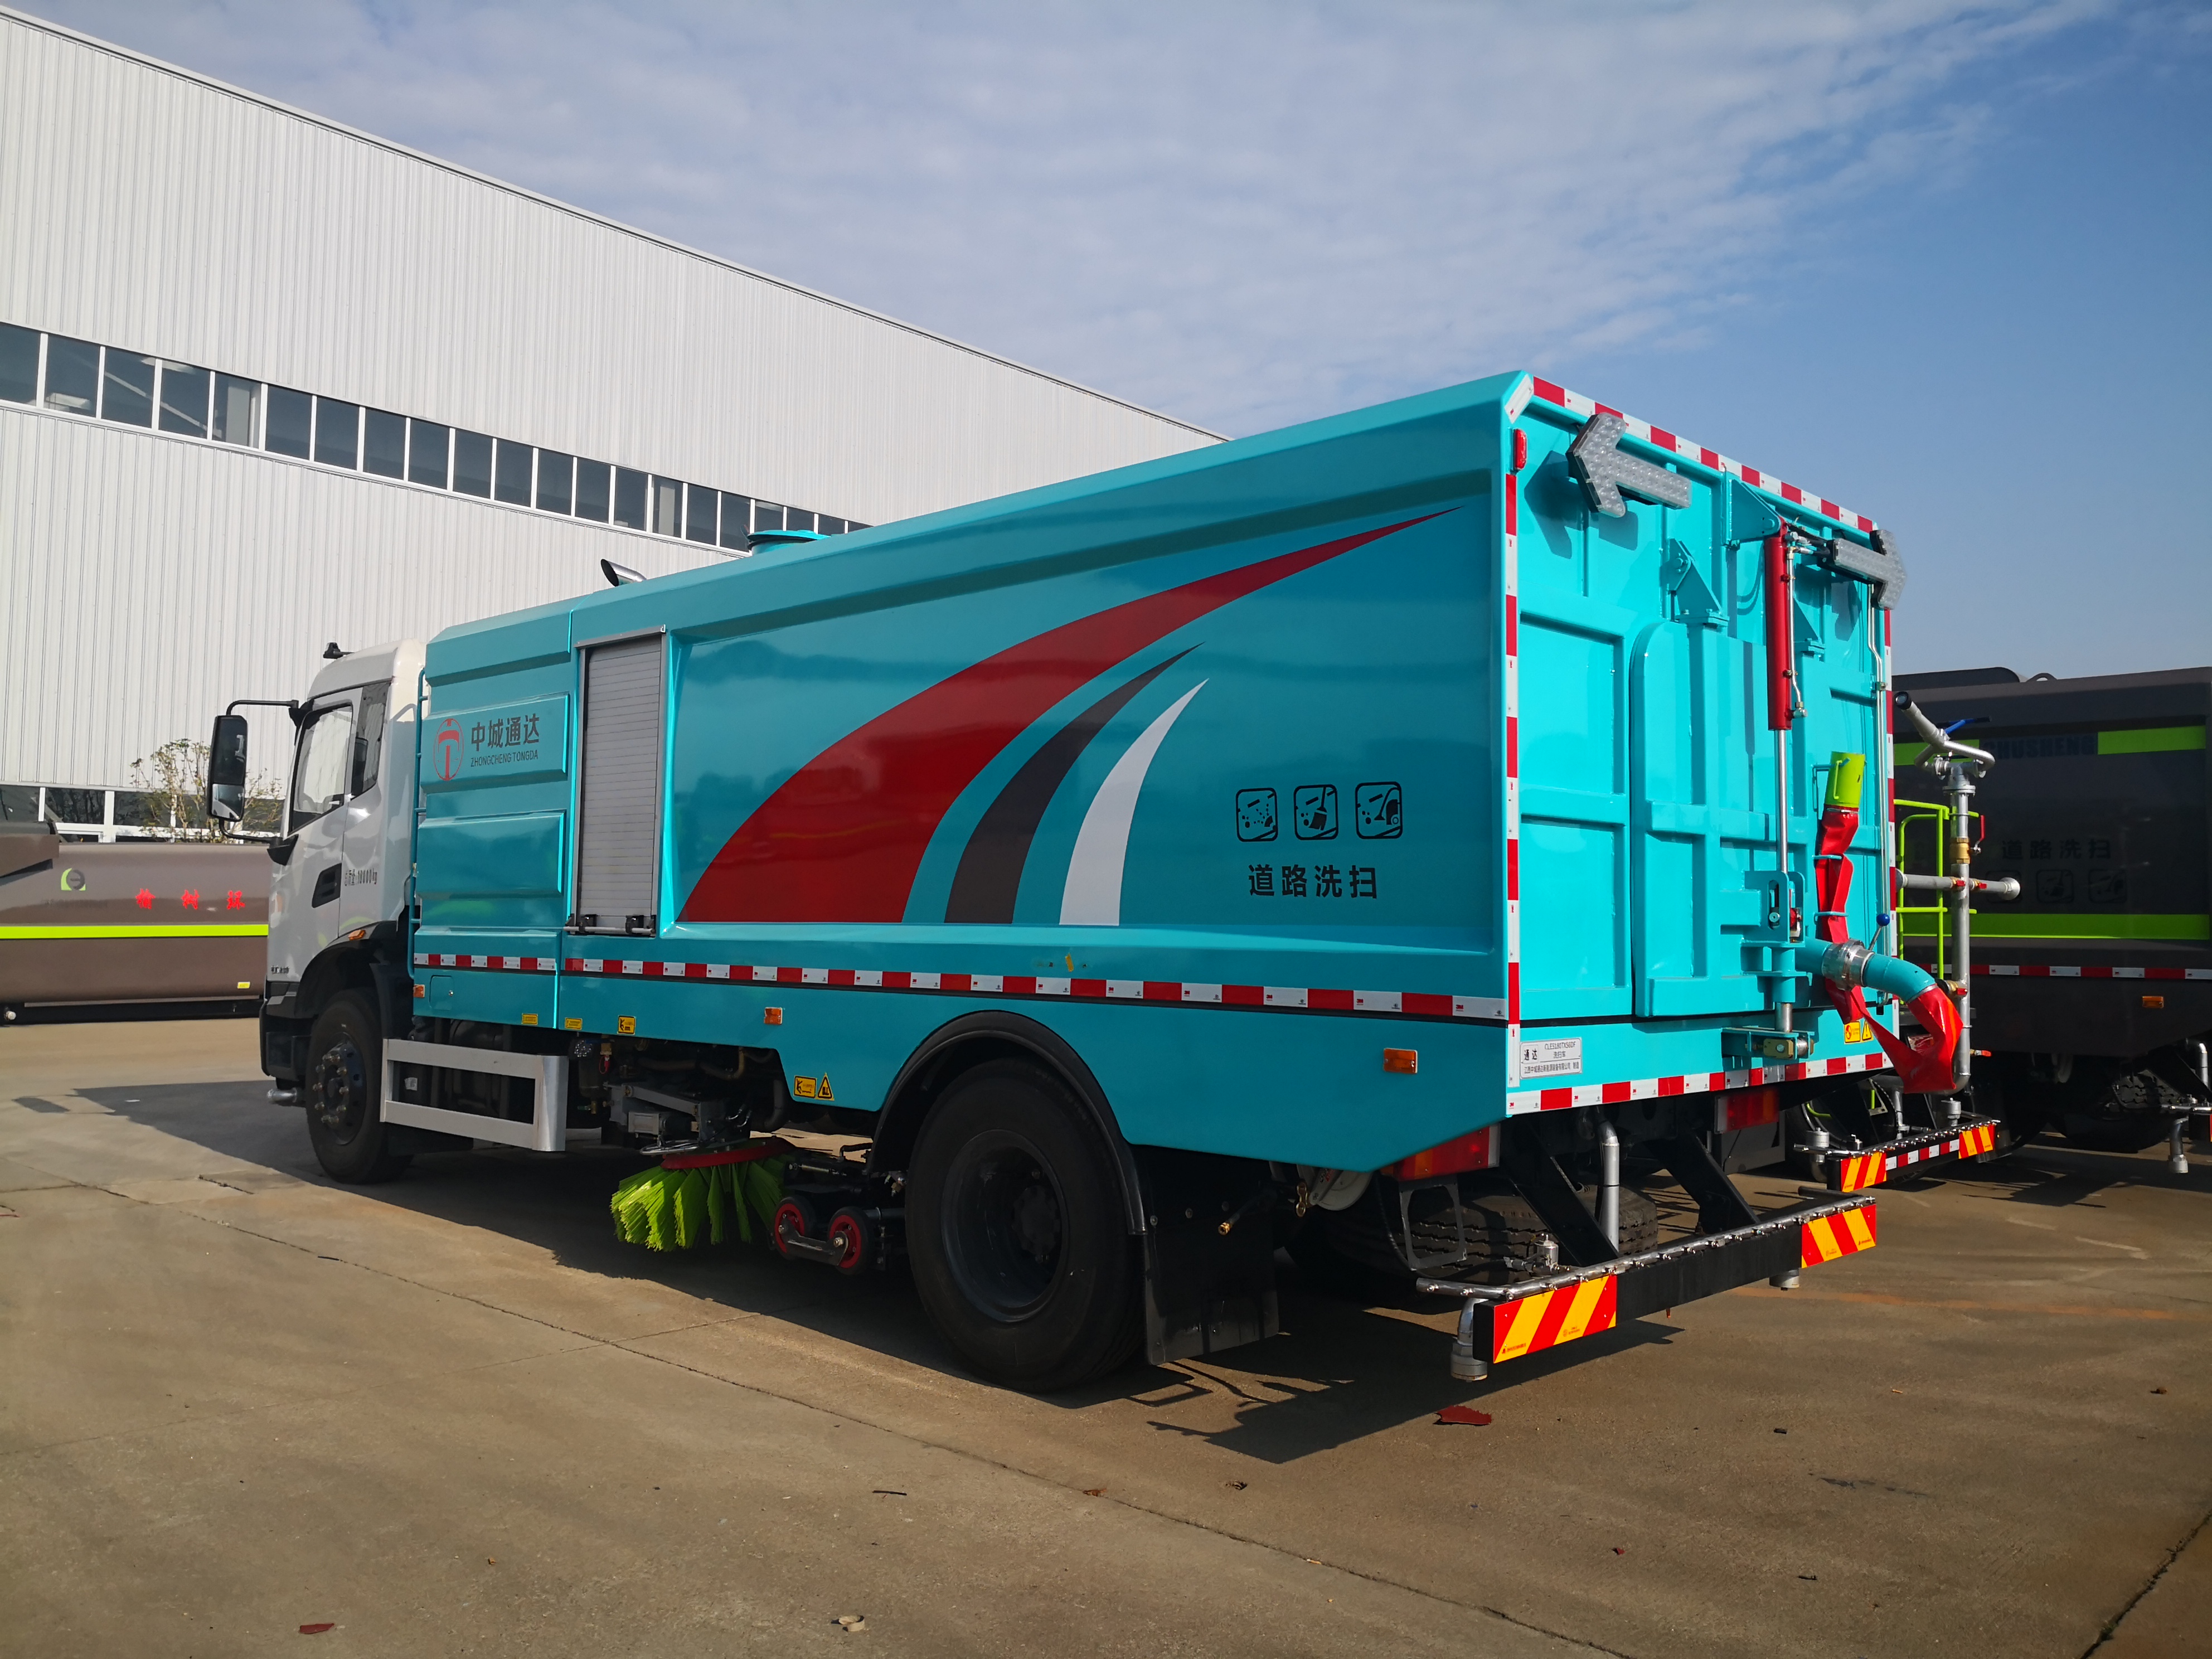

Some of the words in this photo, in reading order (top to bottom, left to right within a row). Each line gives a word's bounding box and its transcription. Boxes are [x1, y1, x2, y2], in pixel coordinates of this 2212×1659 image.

[471, 713, 540, 751] 中城通达
[470, 754, 512, 767] ZHONGCHENG
[512, 750, 539, 762] TONGDA
[2002, 838, 2110, 860] 道路洗扫
[1248, 864, 1377, 899] 道路洗扫
